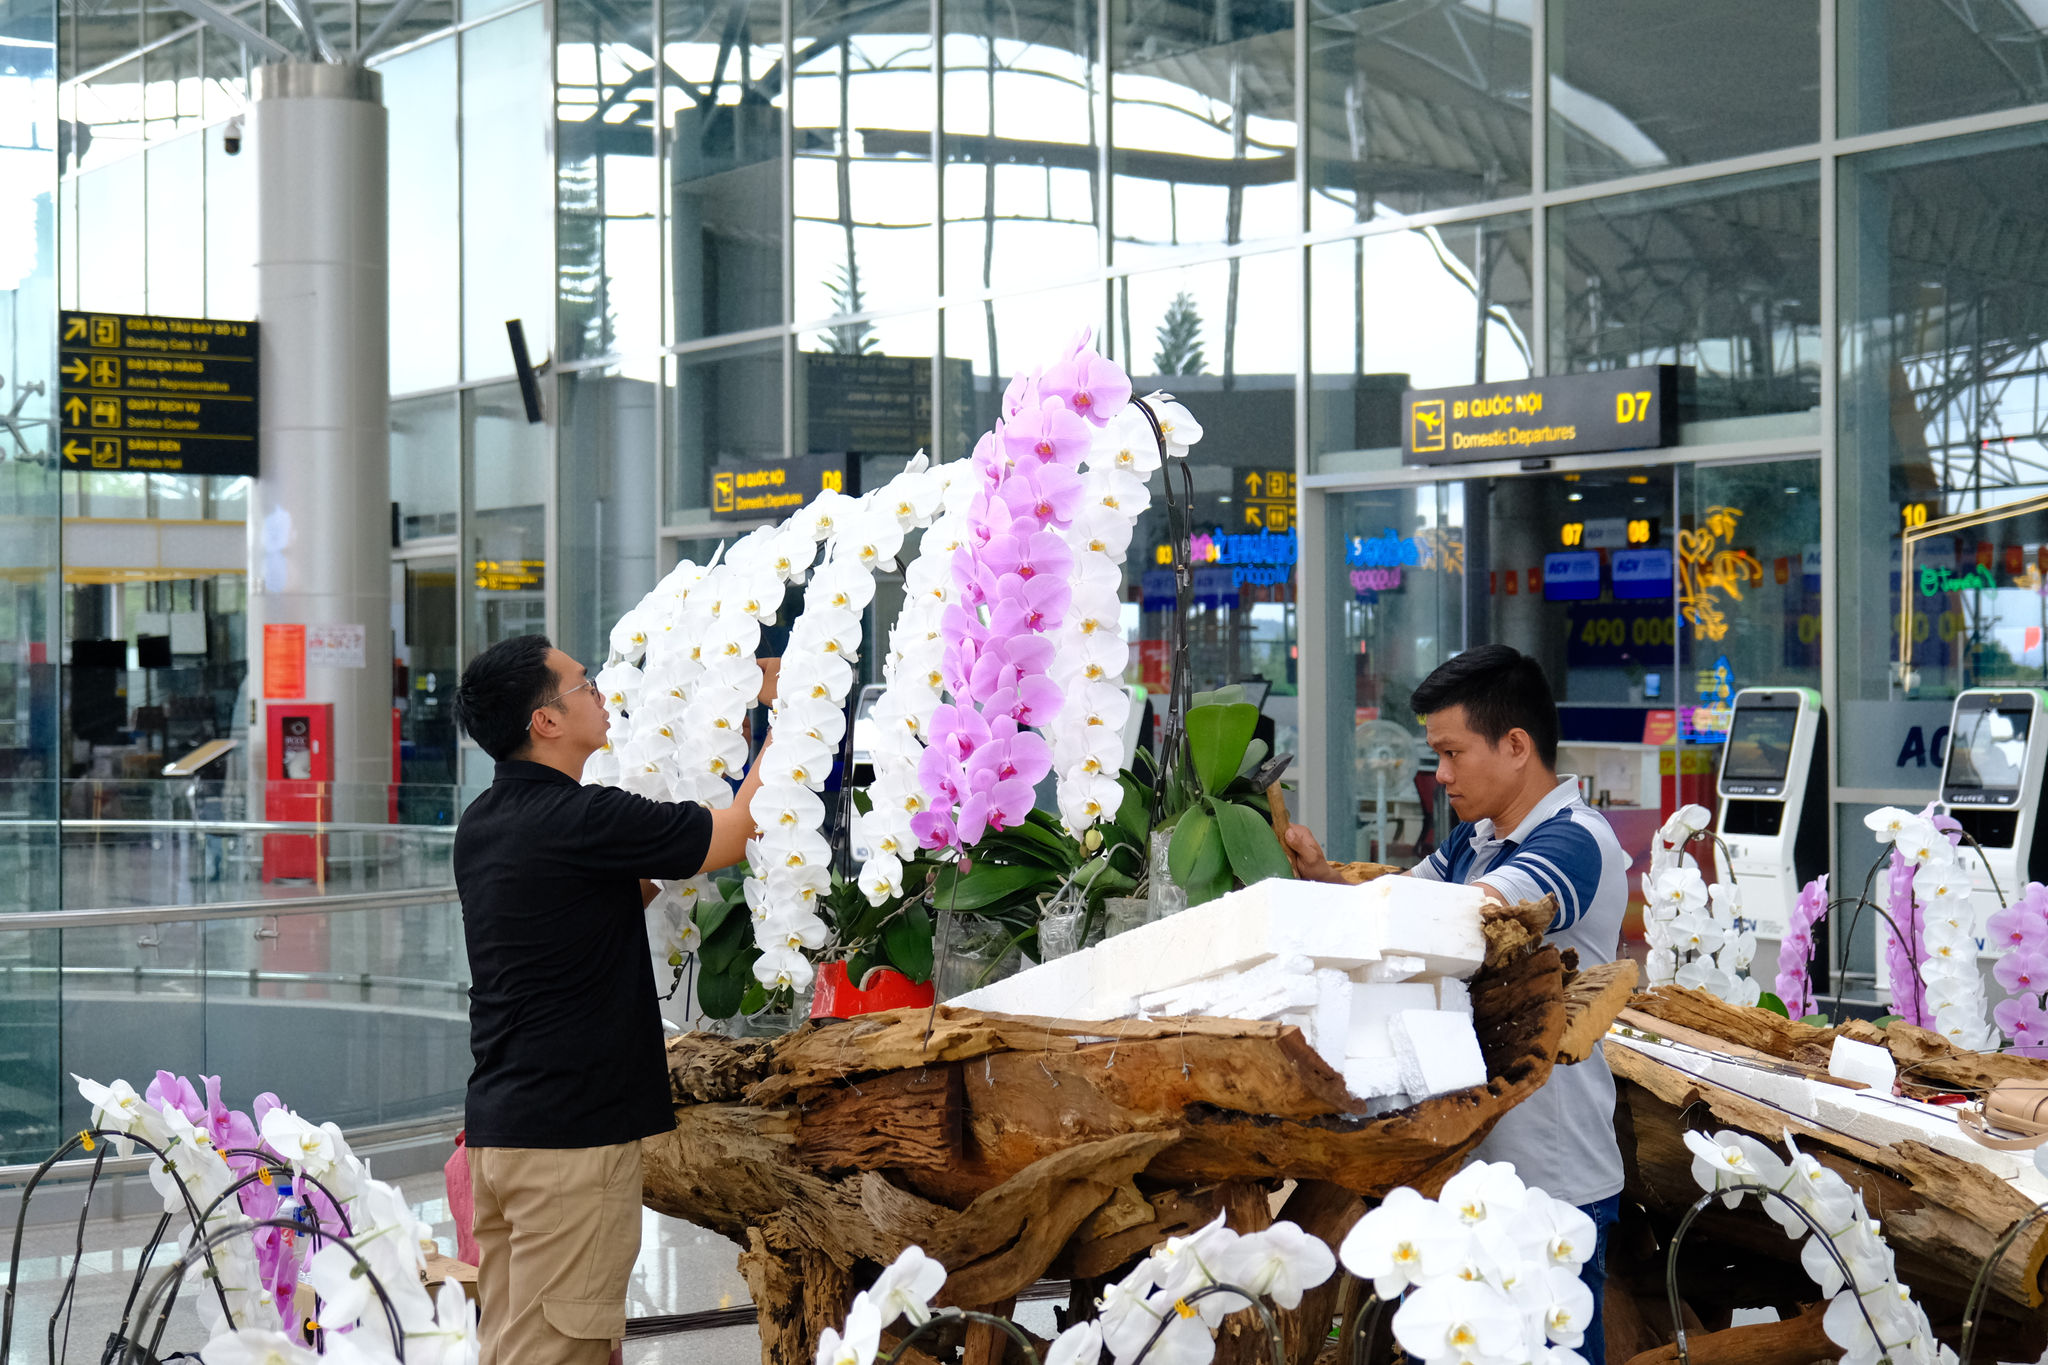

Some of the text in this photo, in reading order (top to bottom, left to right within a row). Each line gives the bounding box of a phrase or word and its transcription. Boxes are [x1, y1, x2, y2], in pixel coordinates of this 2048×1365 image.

[1453, 390, 1542, 419] ĐI QUỐC NỘI
[1615, 391, 1652, 424] D7
[1452, 425, 1576, 450] Domestic Departures
[822, 470, 842, 493] D8
[1902, 503, 1927, 527] 10
[1561, 523, 1584, 546] 07
[1627, 519, 1650, 543] 08
[1581, 617, 1625, 646] 490
